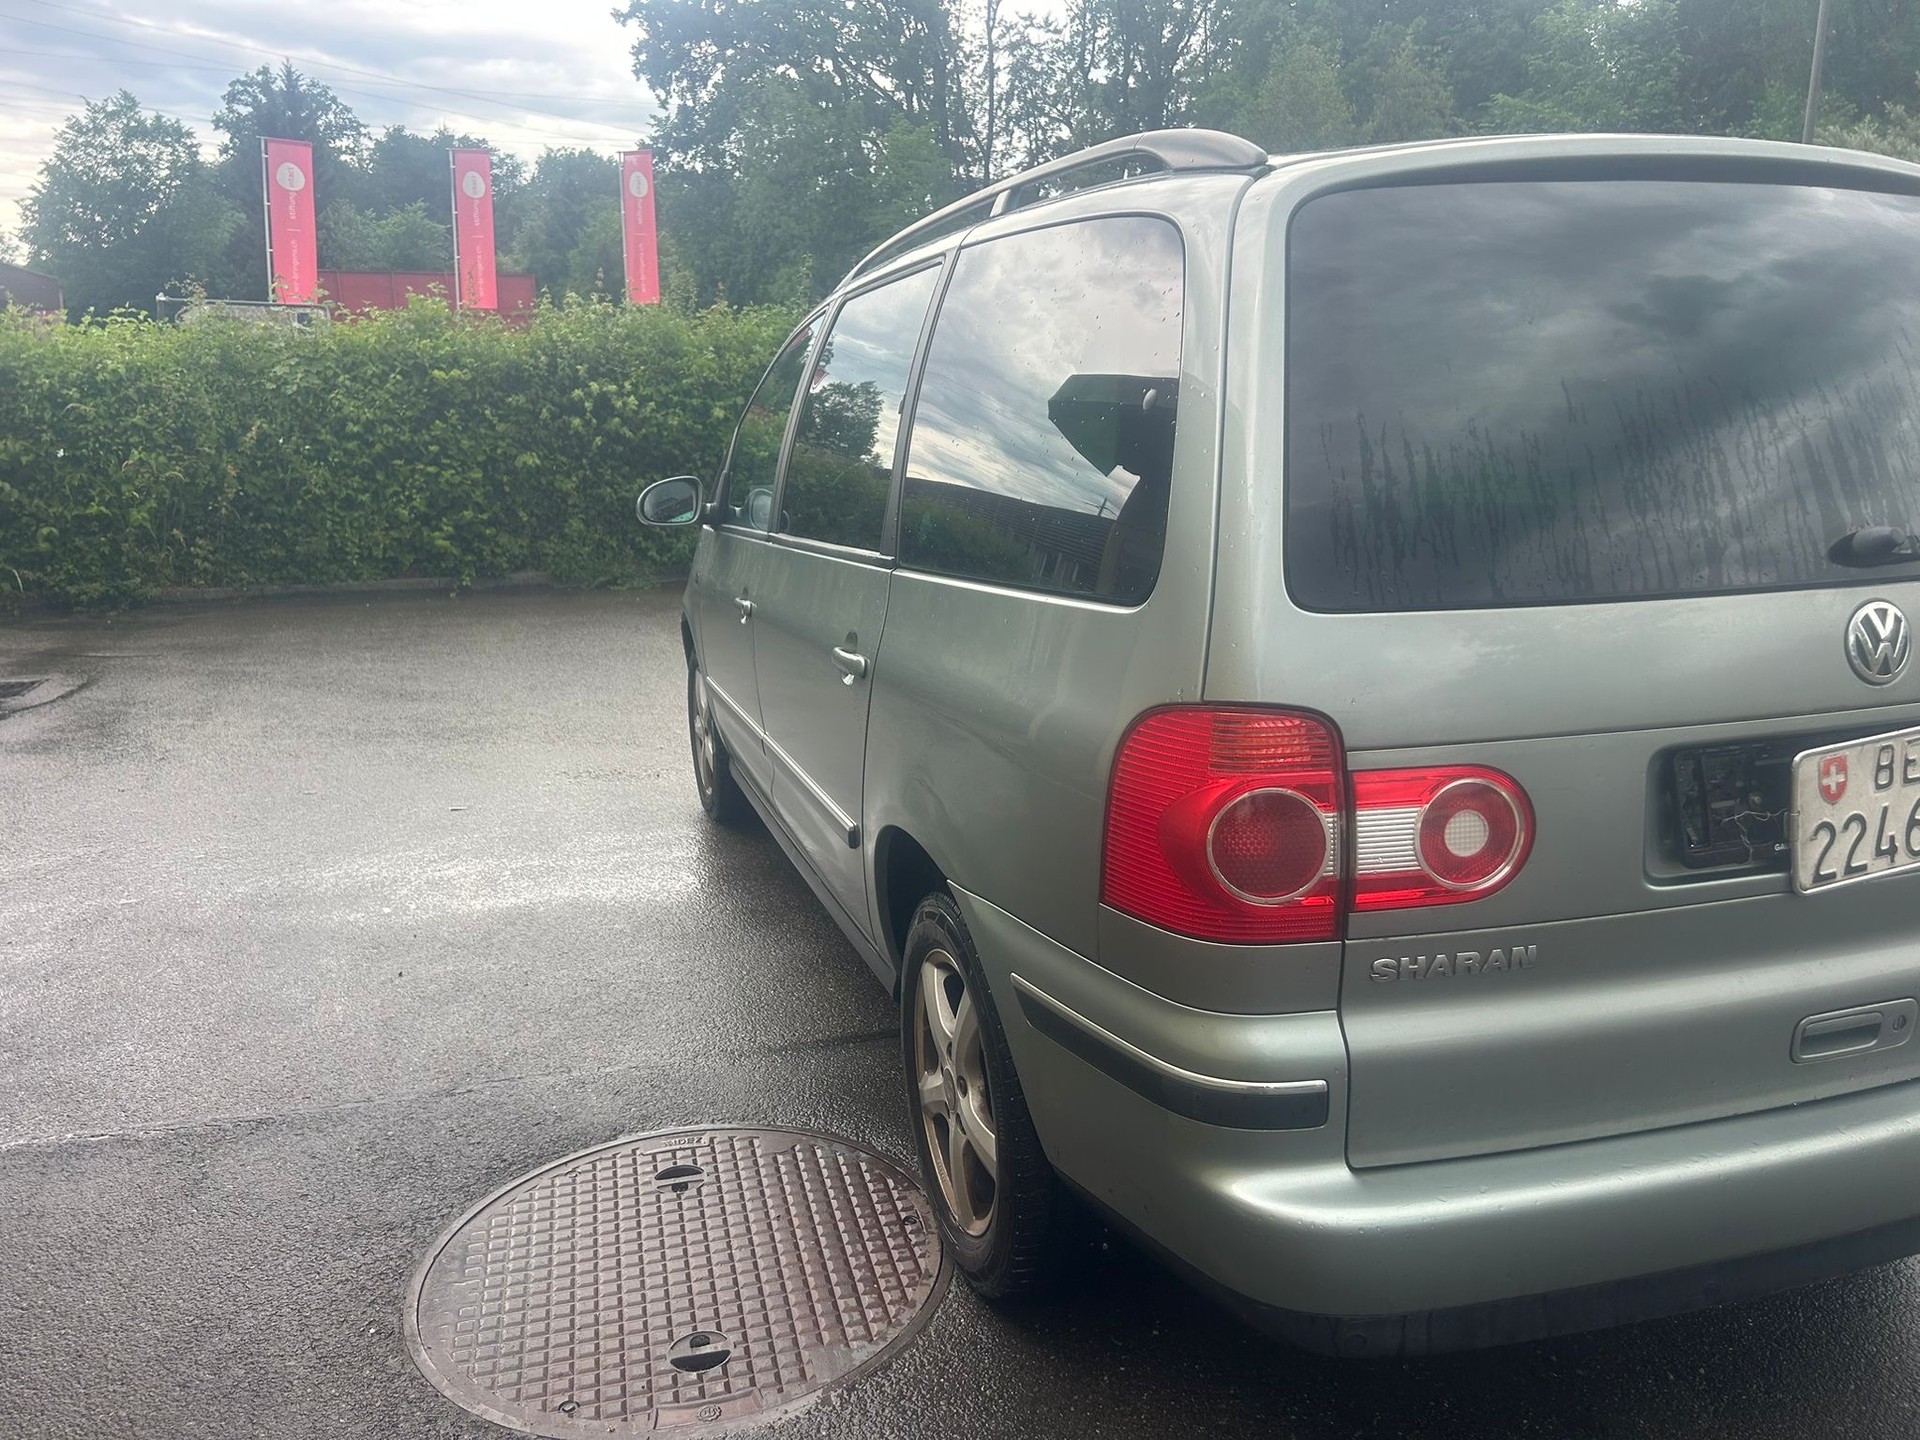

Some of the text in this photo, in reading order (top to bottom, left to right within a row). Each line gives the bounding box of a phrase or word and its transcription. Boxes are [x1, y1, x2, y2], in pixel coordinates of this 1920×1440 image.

[288, 192, 297, 220] stiftung
[1849, 600, 1911, 684] VW
[1874, 738, 1920, 790] BE
[1369, 944, 1537, 983] SHARAN
